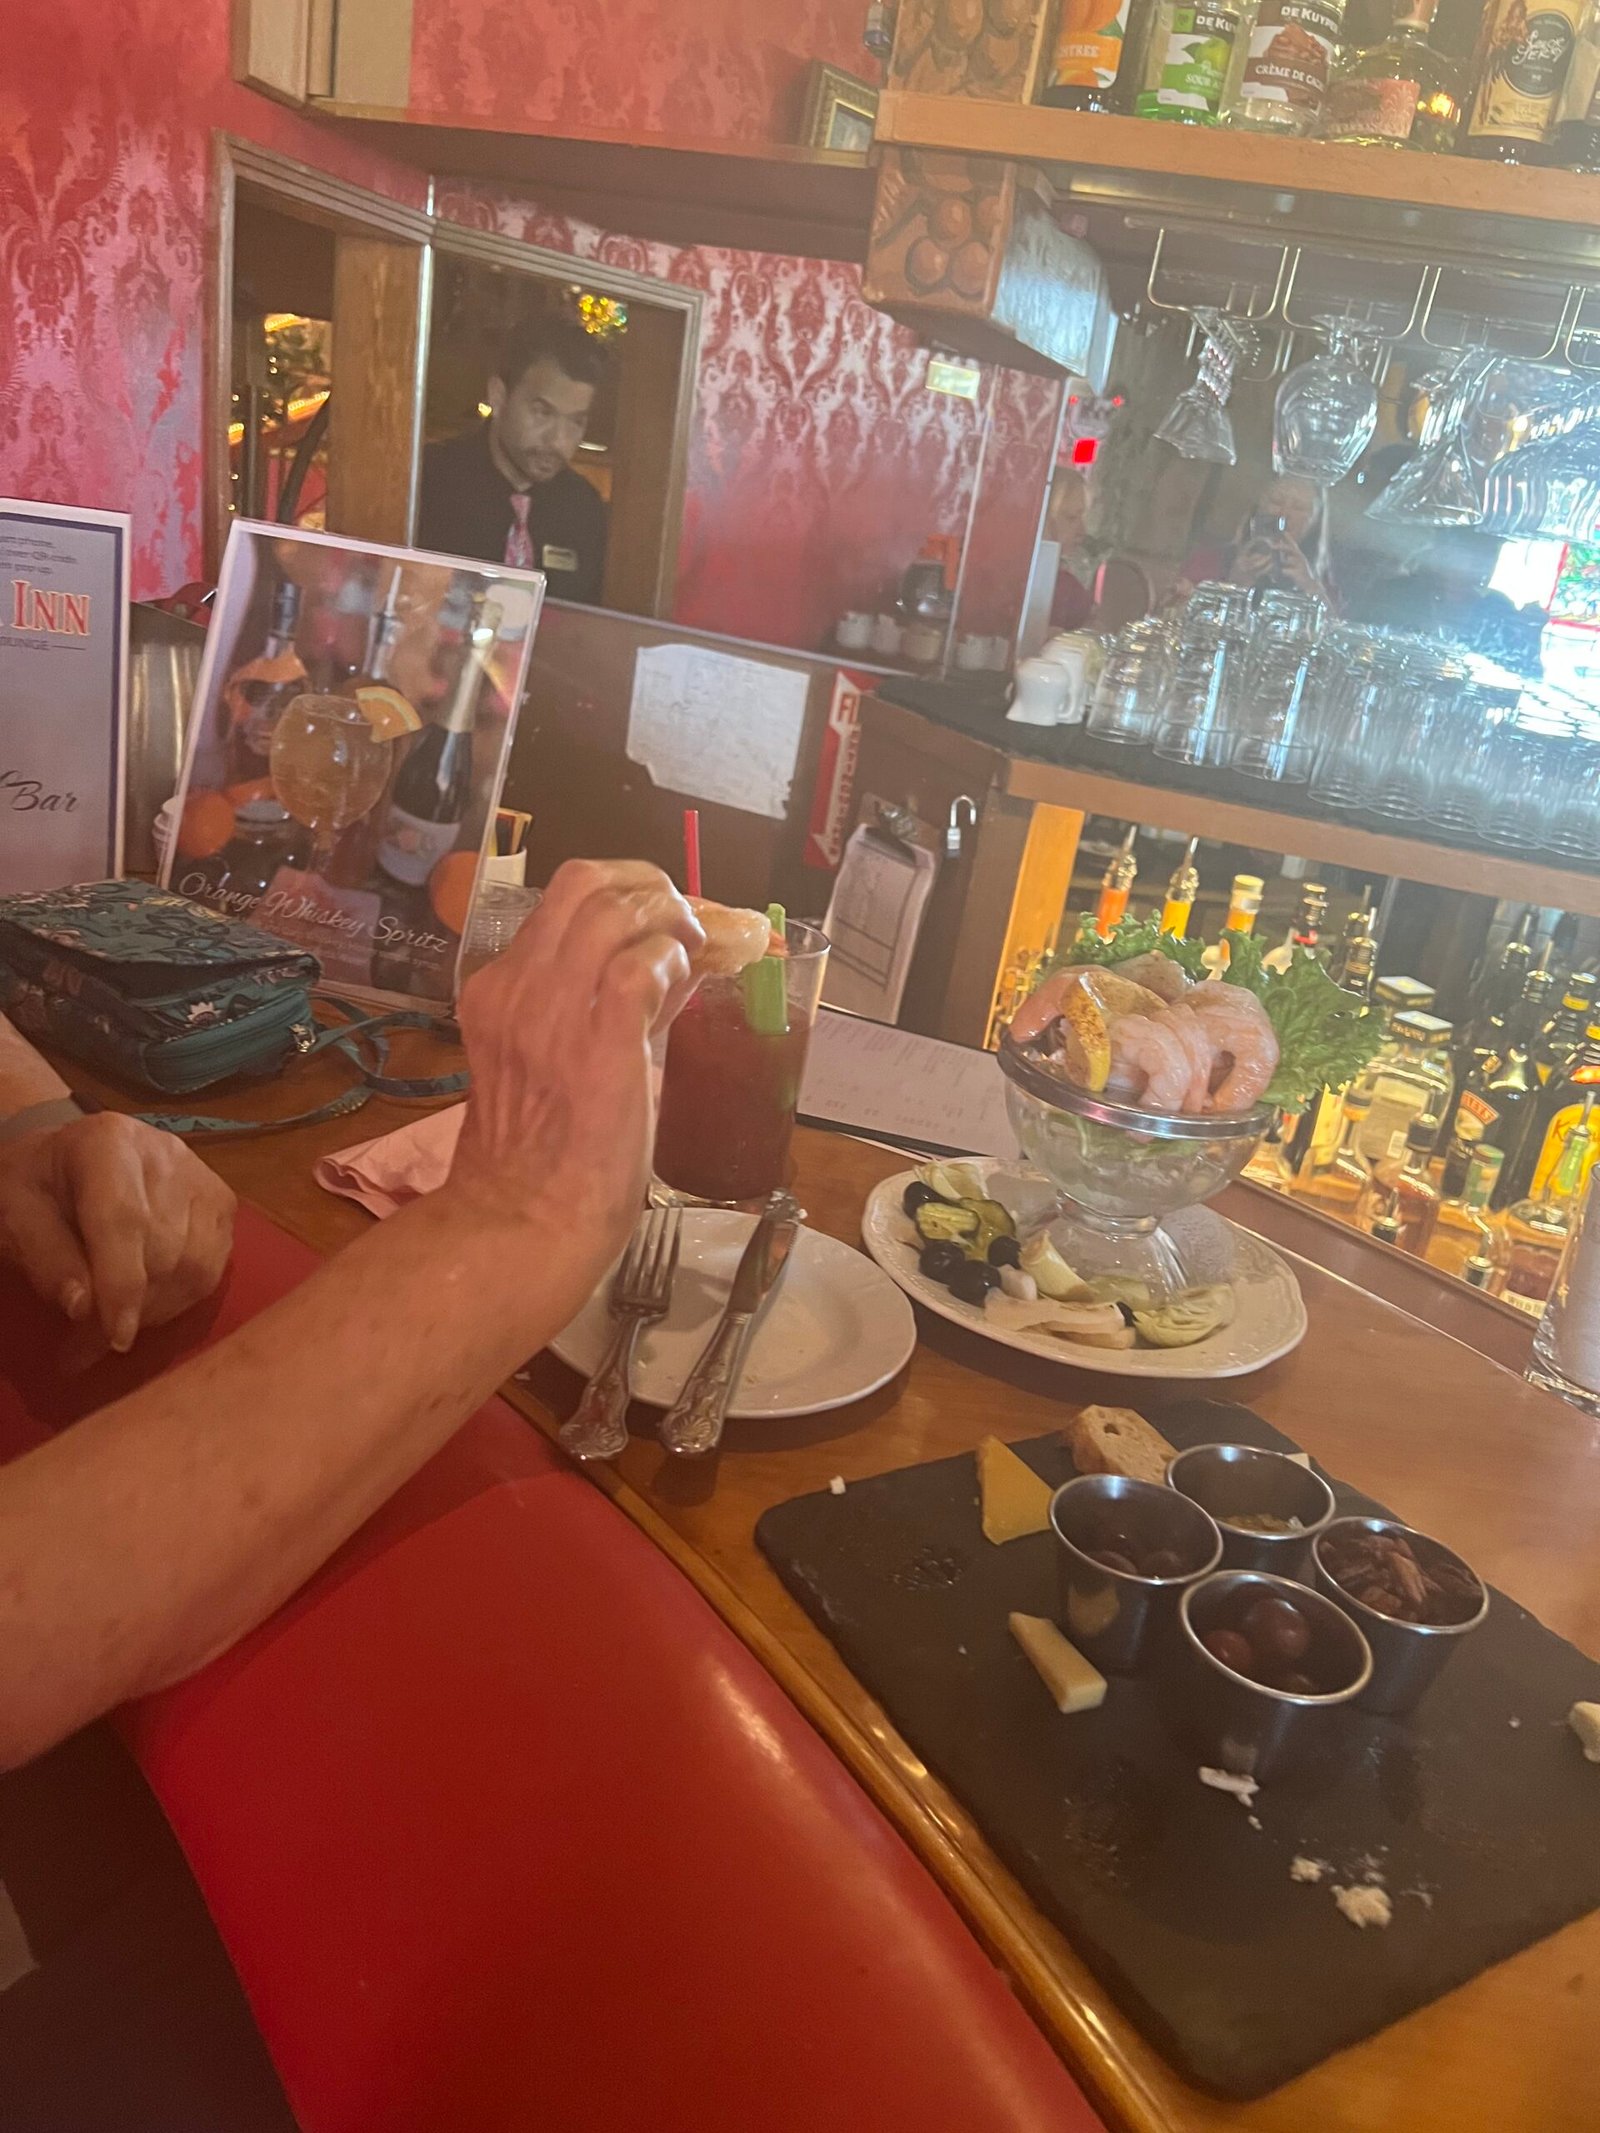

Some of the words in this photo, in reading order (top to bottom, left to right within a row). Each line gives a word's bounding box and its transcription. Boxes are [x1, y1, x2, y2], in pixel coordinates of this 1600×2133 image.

[1281, 6, 1299, 17] DE
[5, 780, 78, 813] Bar
[179, 871, 263, 913] Orange
[264, 890, 366, 939] Whiskey
[367, 916, 448, 953] Spritz
